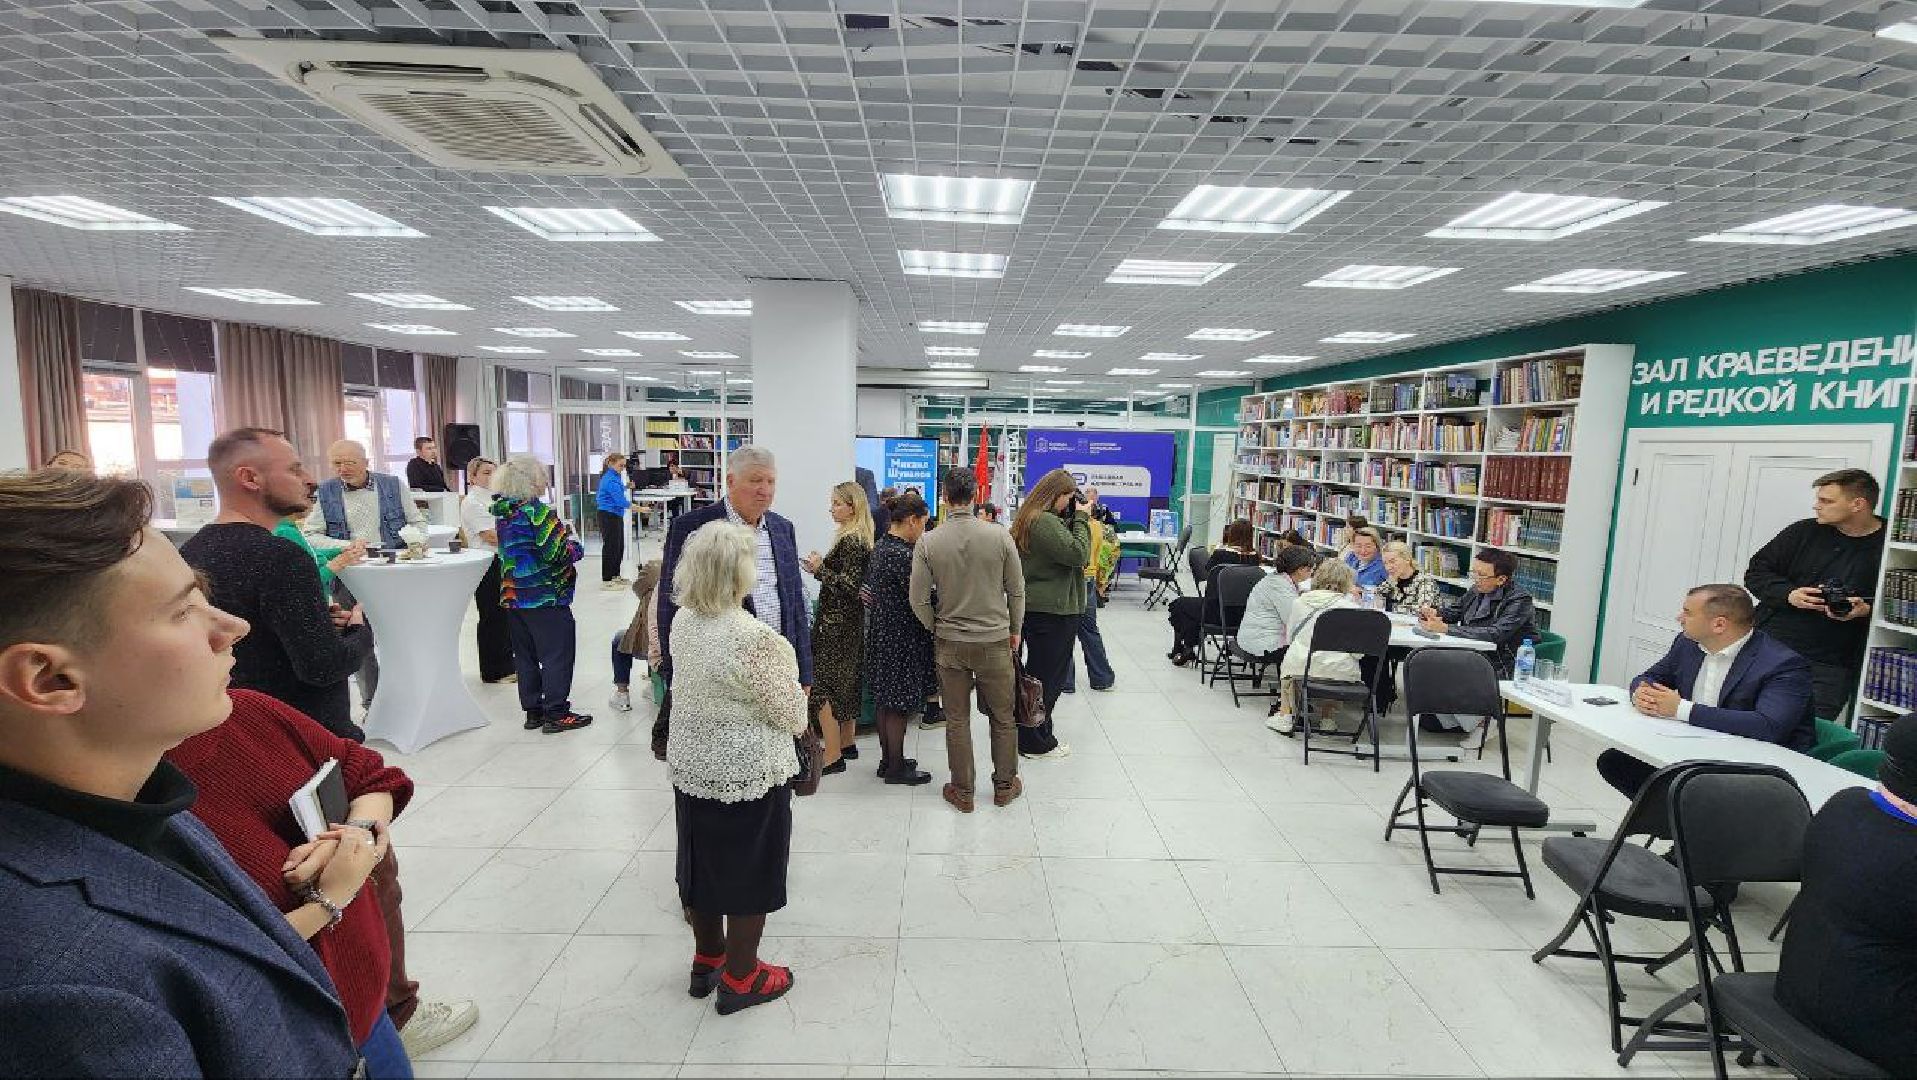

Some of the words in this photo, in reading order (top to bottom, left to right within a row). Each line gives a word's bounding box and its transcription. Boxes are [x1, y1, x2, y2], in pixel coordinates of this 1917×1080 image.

[1632, 358, 1690, 385] ЗАЛ
[1640, 392, 1661, 415] И
[1666, 379, 1798, 418] РЕДКОЙ
[1810, 377, 1917, 410] КНИГ
